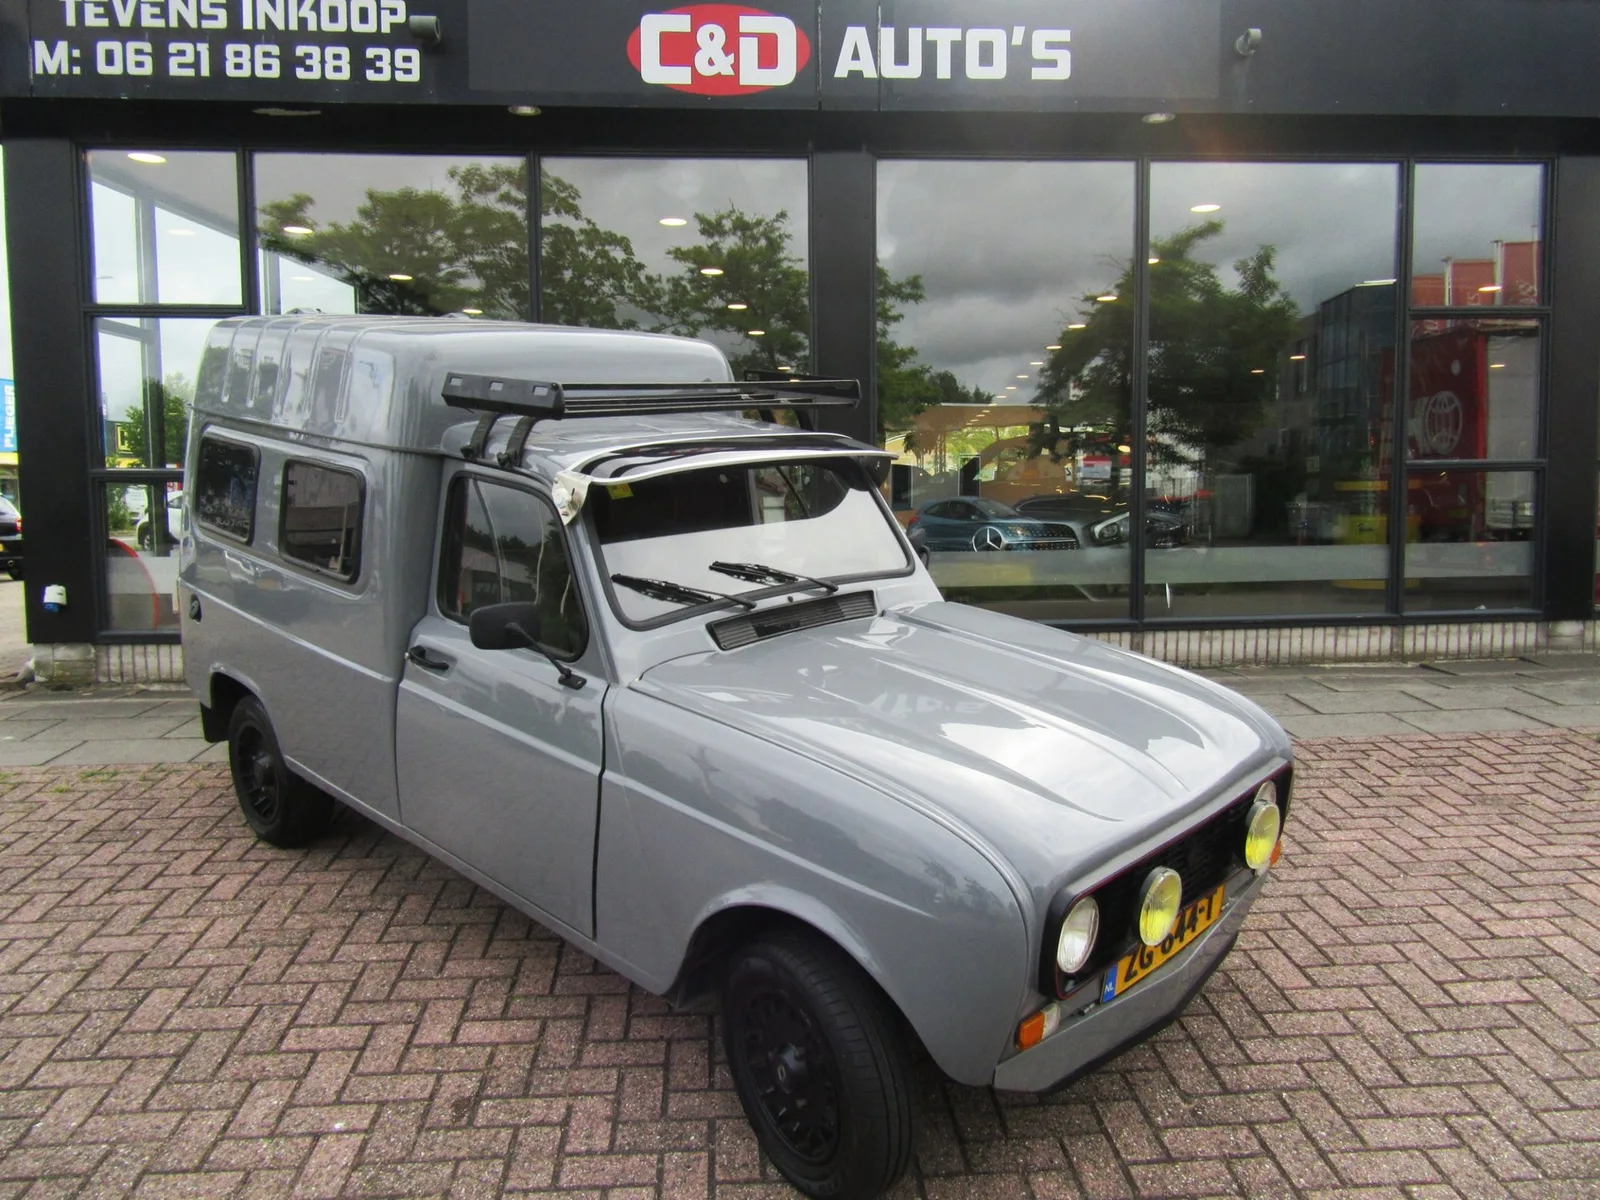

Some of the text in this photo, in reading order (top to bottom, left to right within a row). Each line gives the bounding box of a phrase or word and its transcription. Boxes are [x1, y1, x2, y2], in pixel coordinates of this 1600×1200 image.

[59, 0, 406, 33] TEVENS INKOOP
[34, 40, 420, 82] M: 06 21 86 38 39
[640, 14, 1071, 86] C&D AUTO'S
